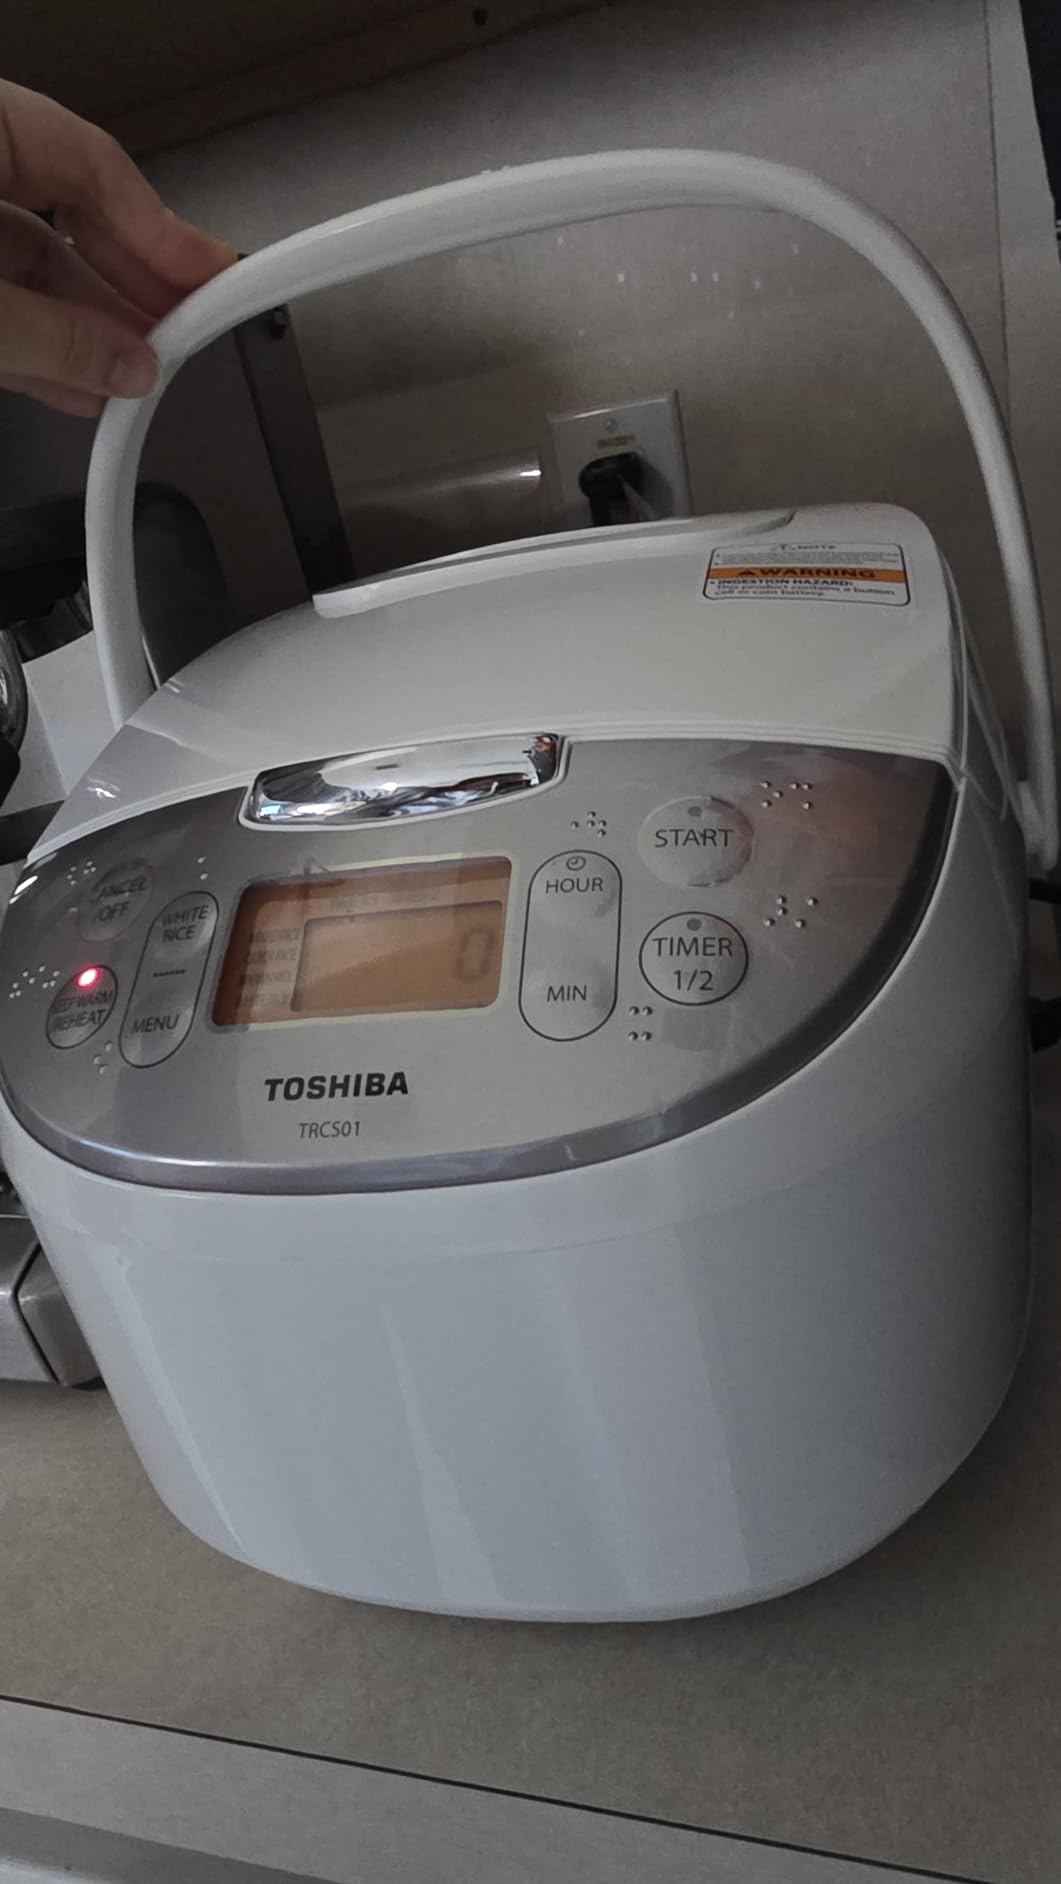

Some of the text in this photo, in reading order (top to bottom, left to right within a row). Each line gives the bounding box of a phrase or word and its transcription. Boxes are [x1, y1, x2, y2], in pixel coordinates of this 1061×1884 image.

[759, 568, 877, 579] WARNING
[654, 828, 734, 848] START
[545, 876, 604, 894] HOUR
[161, 905, 209, 926] WHITE
[162, 925, 196, 944] RICE
[653, 937, 734, 957] TIMER
[673, 970, 714, 991] 1/2
[546, 985, 588, 1002] MIN
[131, 1014, 180, 1033] MENU
[264, 1072, 409, 1101] TOSHIBA
[299, 1121, 361, 1139] TRCS01
